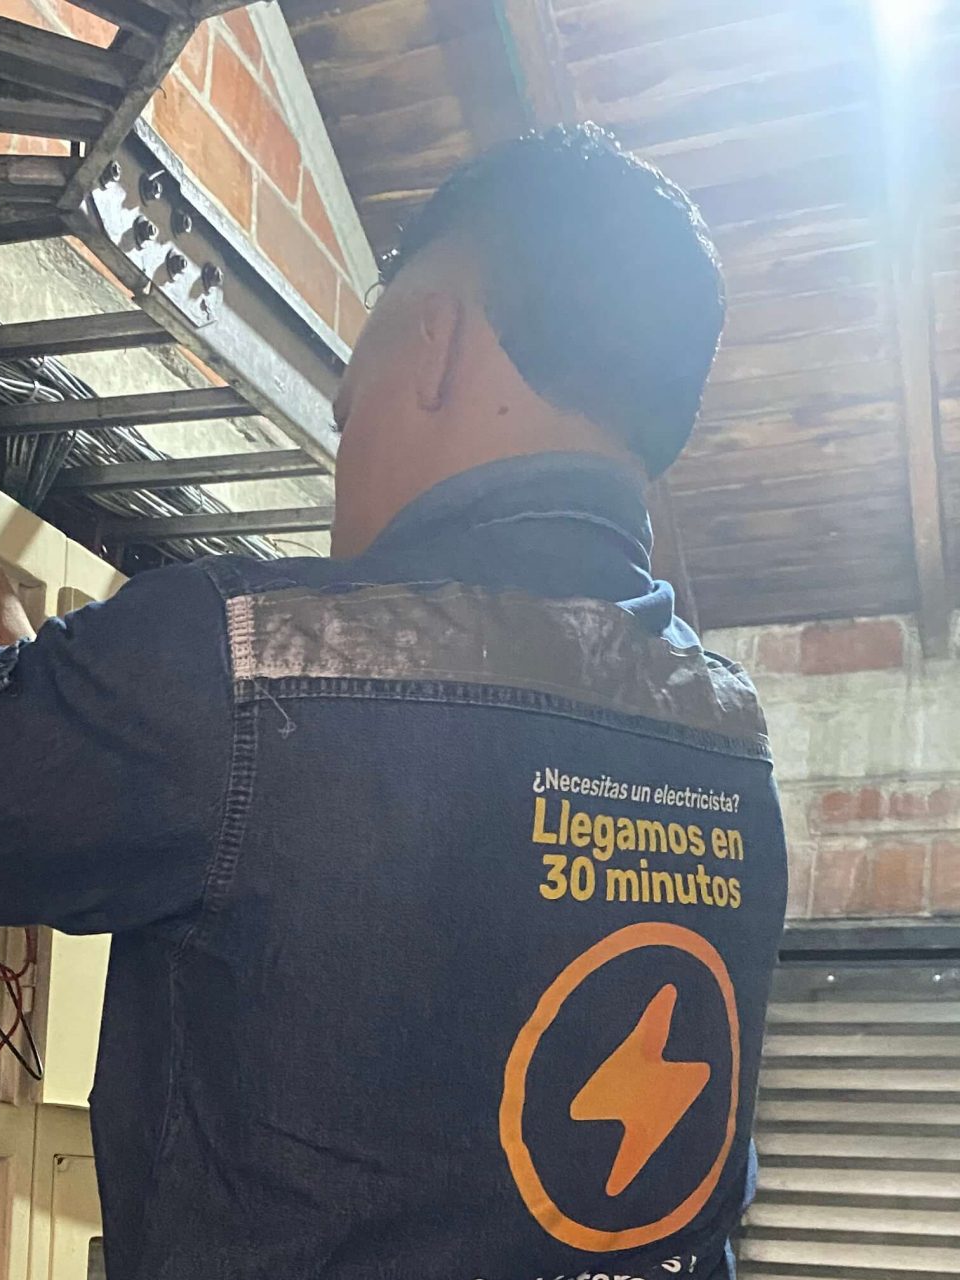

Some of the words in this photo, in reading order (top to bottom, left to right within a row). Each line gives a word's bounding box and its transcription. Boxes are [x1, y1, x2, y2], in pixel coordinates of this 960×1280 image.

[532, 767, 628, 800] ¿Necesitas
[631, 785, 651, 803] un
[654, 784, 740, 813] electricista?
[532, 796, 706, 862] Llegamos
[711, 827, 744, 861] en
[539, 854, 596, 901] 30
[606, 858, 742, 909] minutos
